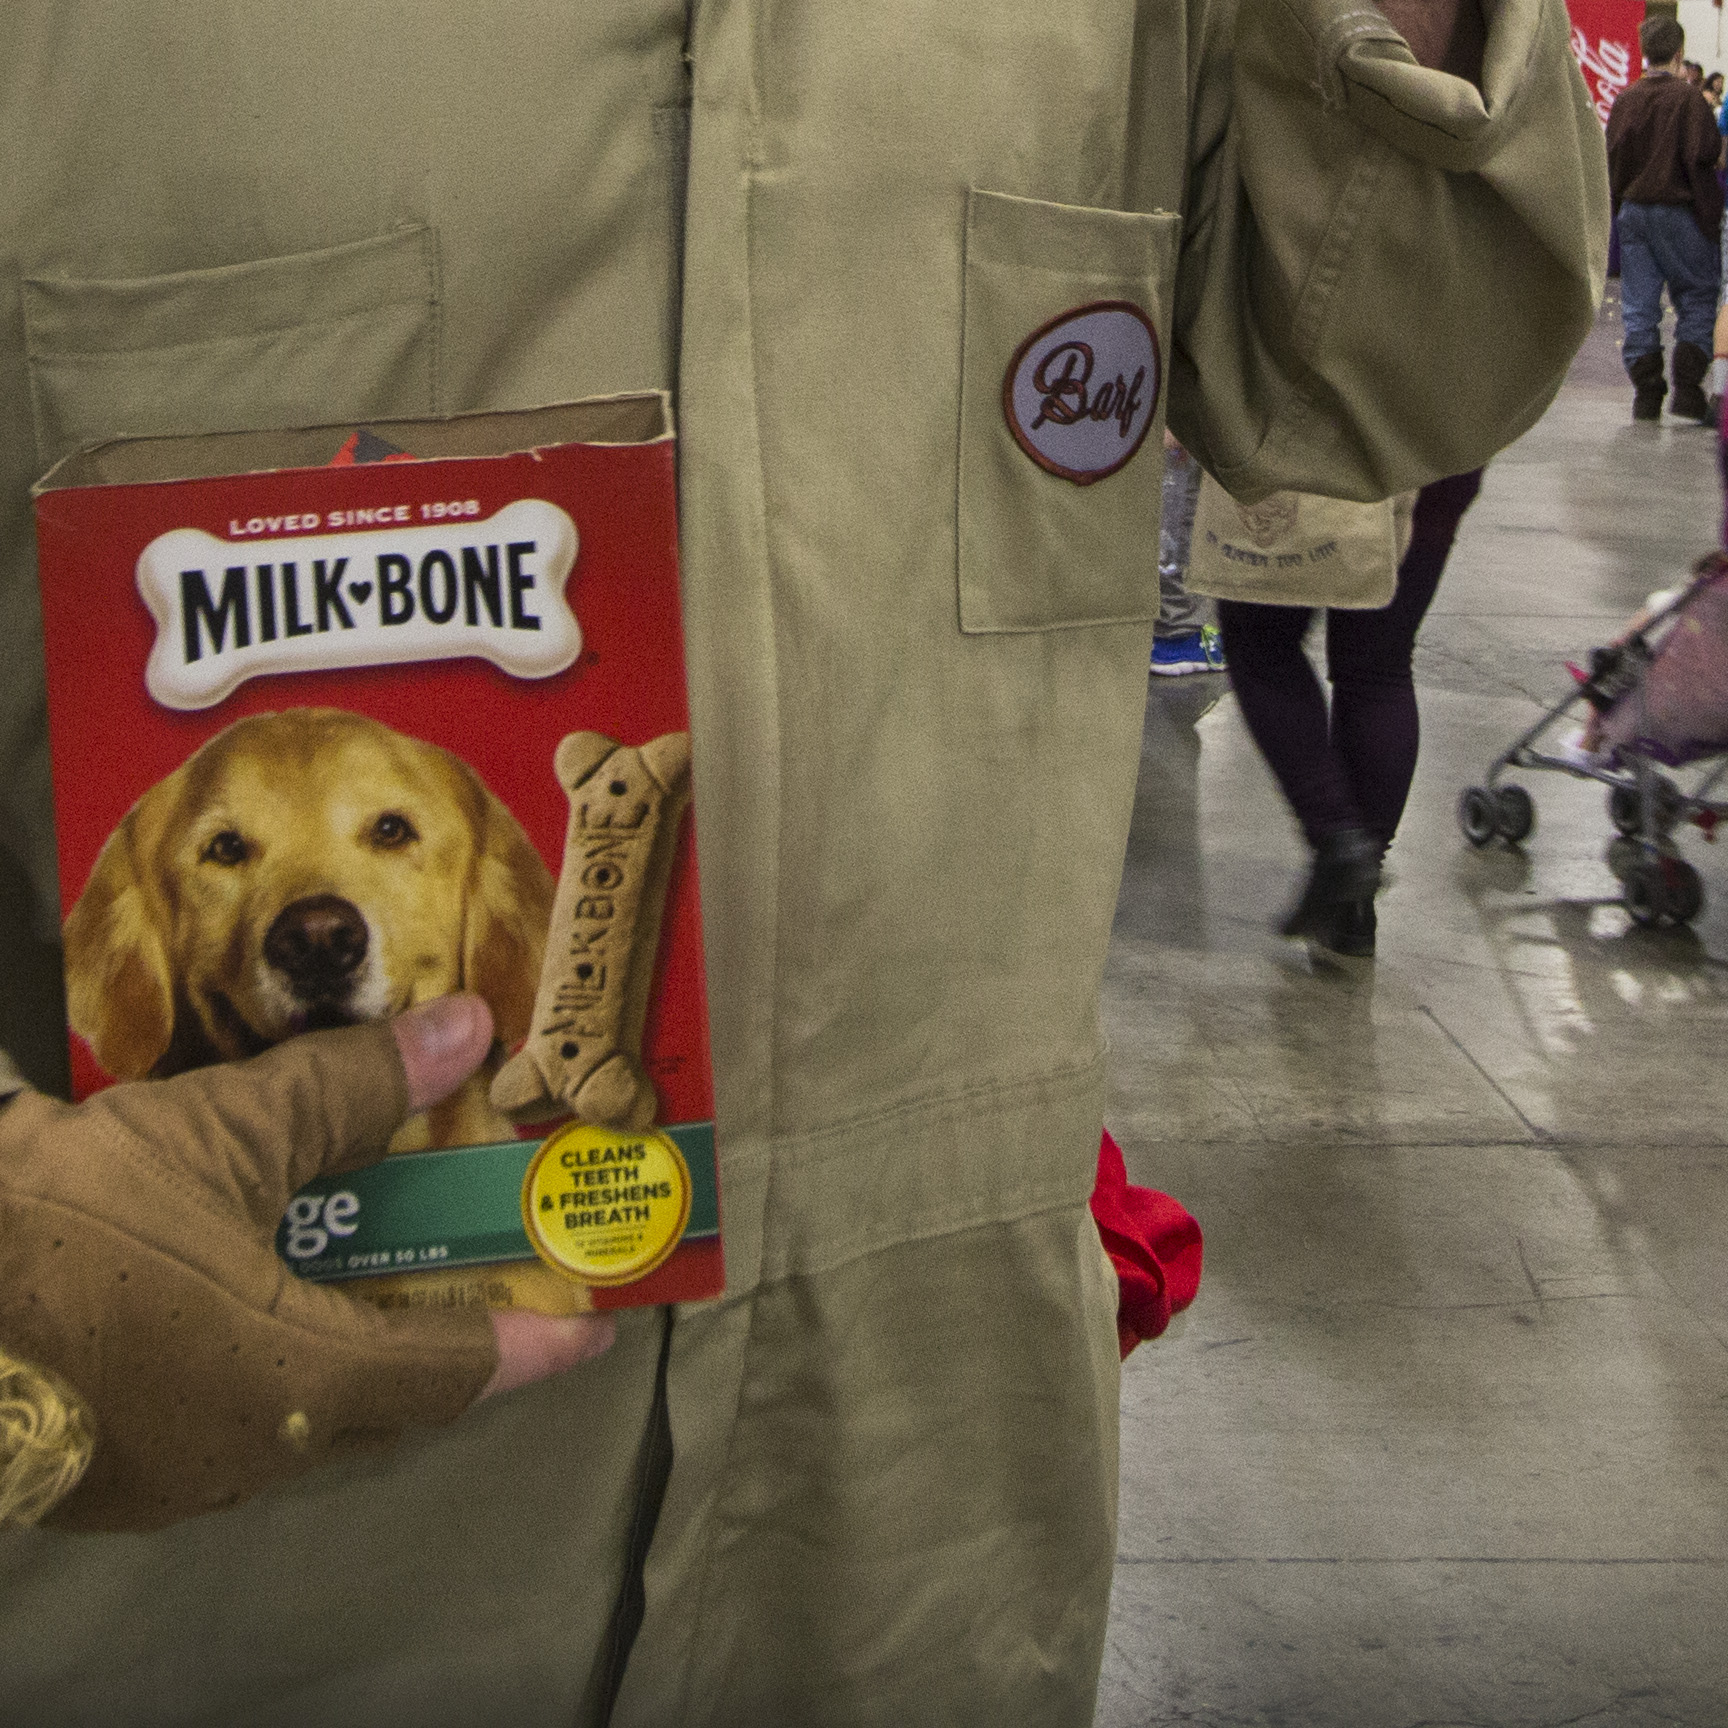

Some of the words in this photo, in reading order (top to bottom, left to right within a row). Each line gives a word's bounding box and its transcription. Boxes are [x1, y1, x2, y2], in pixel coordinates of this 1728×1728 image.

[229, 513, 319, 537] LOVED
[327, 503, 409, 529] SINCE
[420, 498, 480, 519] 1908
[560, 1143, 646, 1168] CLEANS
[570, 1165, 639, 1187] TEETH
[540, 1194, 553, 1211] &
[559, 1180, 671, 1209] FRESHENS
[564, 1204, 650, 1229] BREATH
[347, 1250, 390, 1269] OVER
[419, 1244, 449, 1262] LBS
